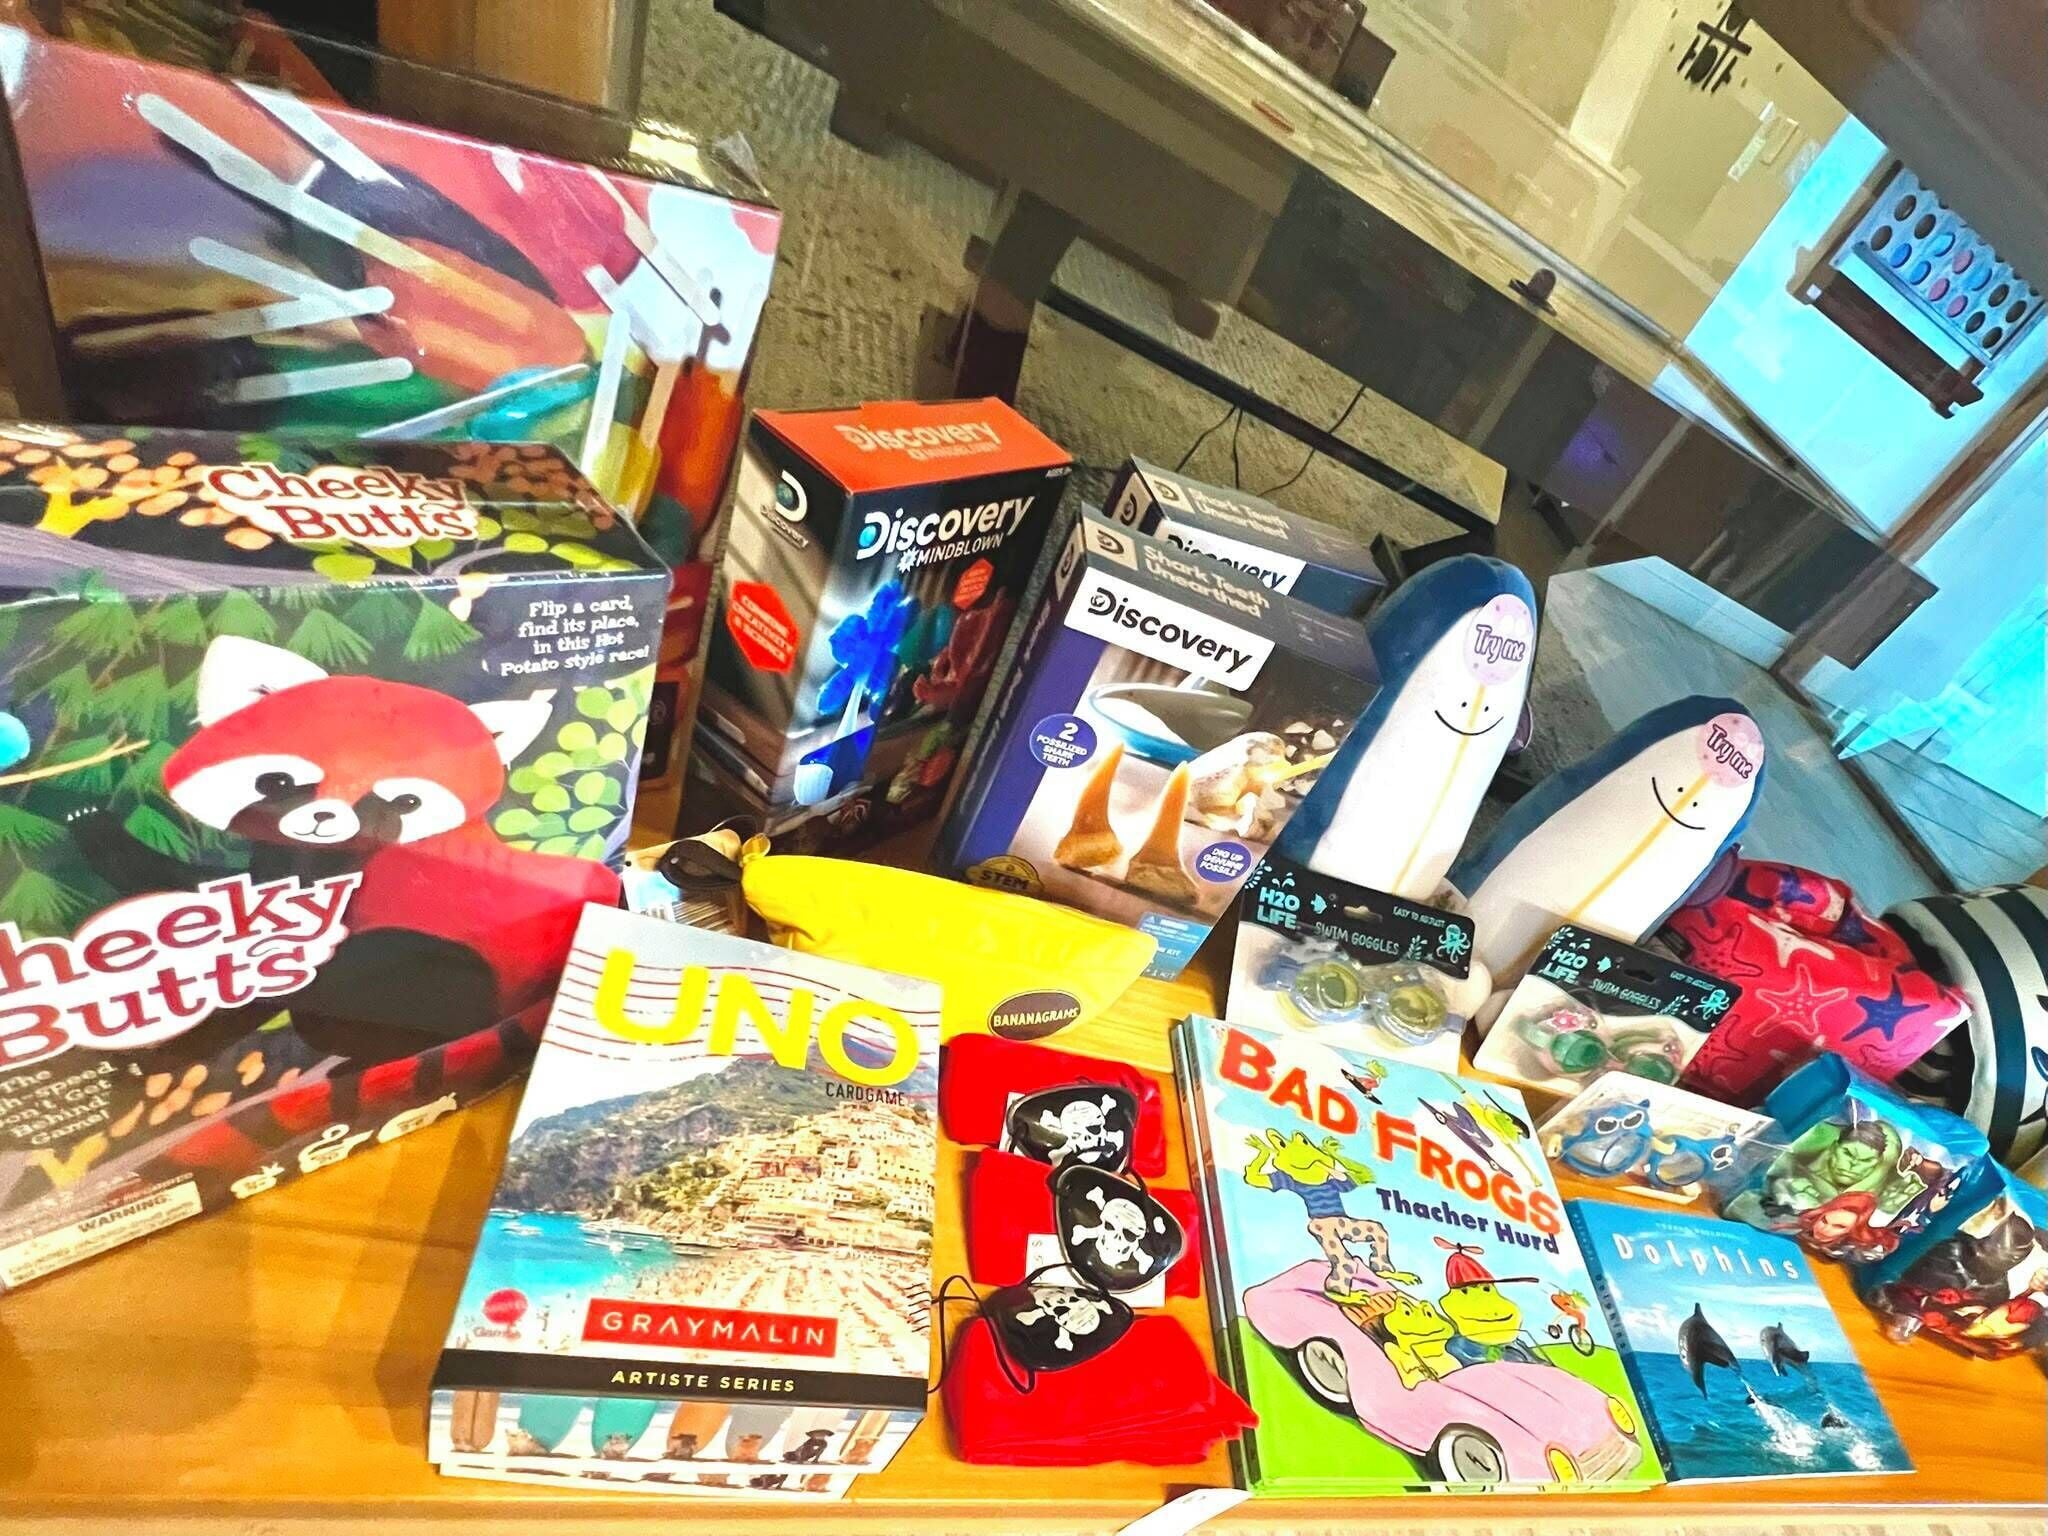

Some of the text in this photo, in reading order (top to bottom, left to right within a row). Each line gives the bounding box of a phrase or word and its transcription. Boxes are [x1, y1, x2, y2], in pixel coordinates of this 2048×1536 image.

[834, 422, 1001, 452] Discovery
[207, 465, 466, 511] Cheeky
[266, 505, 473, 539] Butts
[856, 496, 1035, 560] Discovery
[1143, 545, 1270, 609] Shark Teeth
[1145, 559, 1261, 619] Unearthed
[529, 600, 567, 618] Flip
[573, 602, 584, 614] a
[518, 615, 640, 638] find its place,
[1088, 587, 1252, 673] Discovery
[533, 632, 624, 655] in this Hot
[1475, 624, 1526, 663] Try me
[501, 645, 650, 676] Potato style race!
[1036, 735, 1088, 756] FOSSILIZED
[1059, 722, 1078, 741] 2
[1043, 745, 1075, 760] SHARK
[1706, 724, 1753, 779] Try me
[1200, 860, 1237, 877] FOSSILS
[1211, 848, 1244, 862] DIG UP
[980, 869, 1031, 890] STEM
[1259, 886, 1300, 912] H2O
[1257, 904, 1297, 930] LIFE
[0, 878, 354, 995] heeky
[1314, 922, 1400, 956] SWIM GOGGLES
[1543, 962, 1580, 984] LIFE
[1552, 949, 1588, 970] H2O
[0, 945, 309, 1066] Butts
[1590, 978, 1663, 1011] SWIM GOGGLES
[594, 948, 920, 1088] UNO
[993, 1007, 1079, 1028] BANANAGRAMS
[825, 1080, 906, 1109] CARDGAME
[1219, 1027, 1361, 1135] BAD
[1374, 1111, 1562, 1235] FROGS
[1375, 1187, 1489, 1232] Thacher
[1494, 1220, 1560, 1254] Hurd
[1612, 1232, 1800, 1280] Dolphins
[1594, 1273, 1627, 1350] Dolphins
[602, 1311, 825, 1346] GRAYMALIN
[611, 1369, 796, 1393] ARTISTE SERIES
